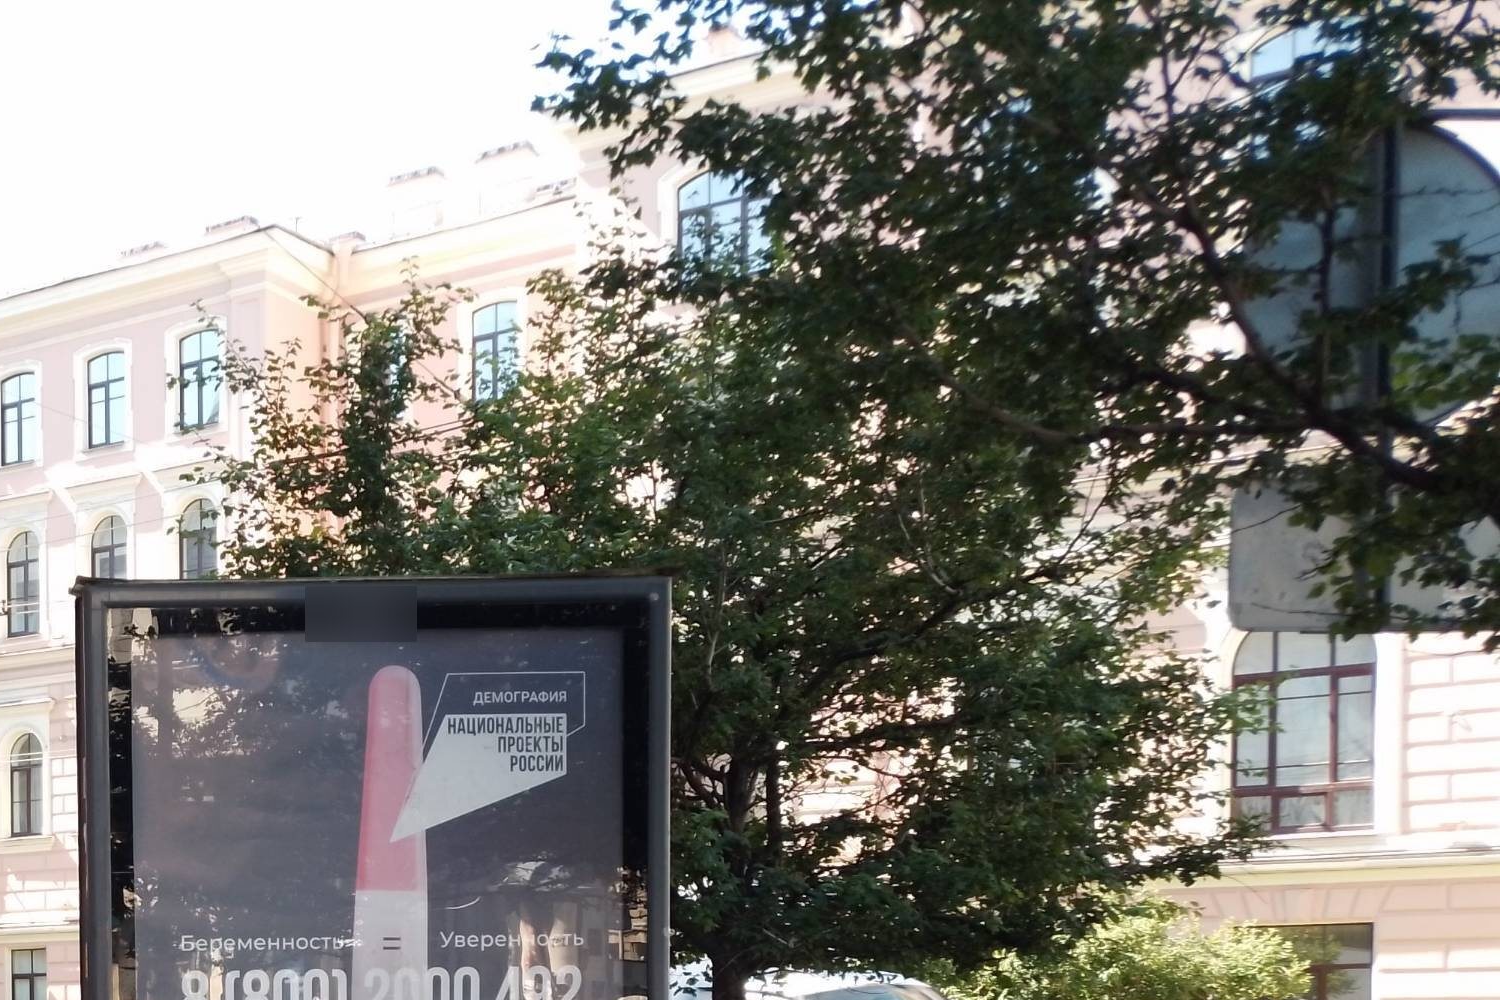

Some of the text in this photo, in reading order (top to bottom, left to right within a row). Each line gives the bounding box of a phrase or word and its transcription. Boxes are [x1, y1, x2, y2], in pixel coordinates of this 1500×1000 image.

[473, 690, 567, 706] ДЕМОГРАФИЯ
[448, 716, 564, 735] НАЦИОНАЛЬНЫЕ
[498, 736, 564, 753] ПРОЕКТЫ
[510, 755, 564, 772] РОССИИ
[181, 935, 344, 953] Беременность
